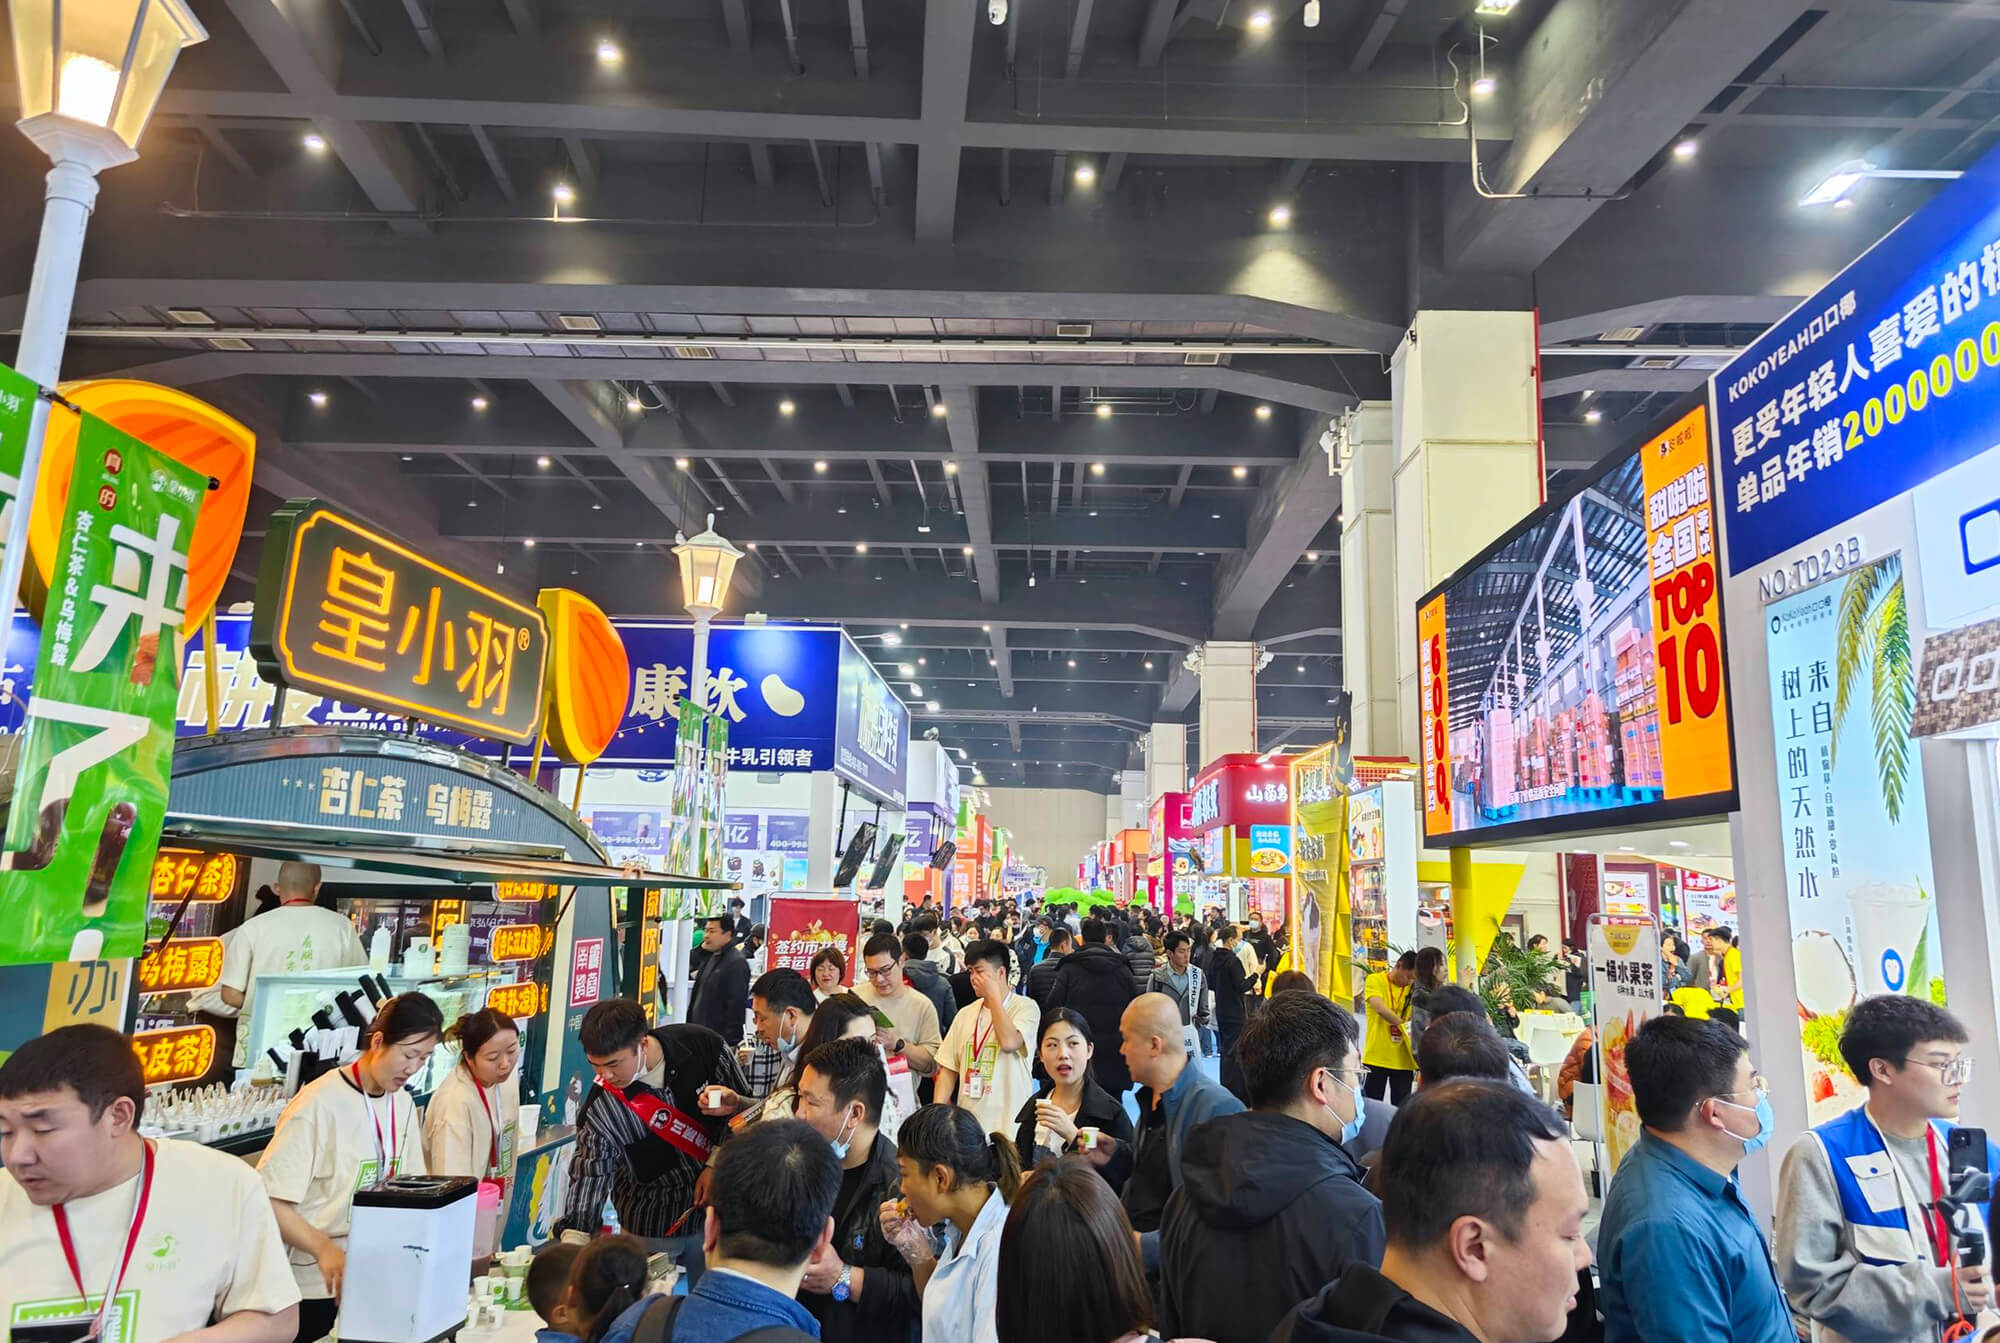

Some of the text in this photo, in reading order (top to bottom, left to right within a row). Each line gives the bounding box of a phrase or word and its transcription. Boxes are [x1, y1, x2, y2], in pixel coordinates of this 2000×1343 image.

[1650, 463, 1708, 532] 甜啦啦
[1652, 514, 1698, 580] 全国
[1653, 561, 1714, 633] TOP
[1658, 622, 1721, 726] 10
[1808, 660, 1833, 735] 来自
[319, 767, 406, 821] 杏仁茶
[1781, 666, 1820, 899] 树上的天然水
[154, 856, 222, 896] 杏仁茶
